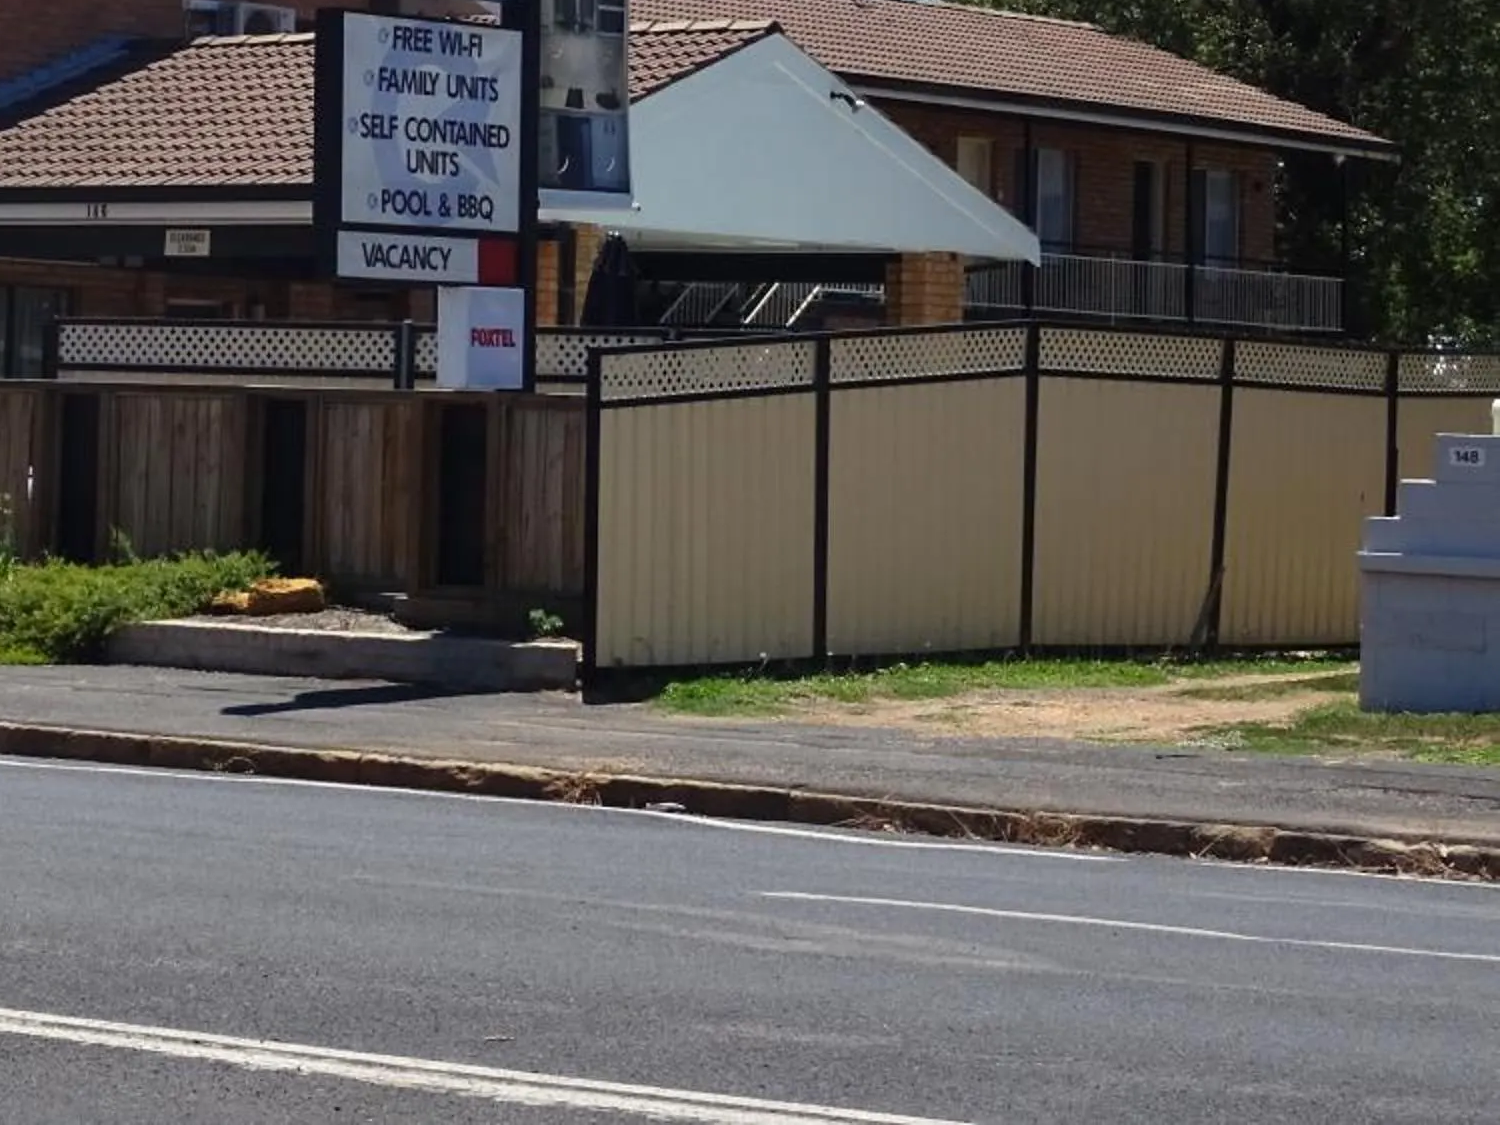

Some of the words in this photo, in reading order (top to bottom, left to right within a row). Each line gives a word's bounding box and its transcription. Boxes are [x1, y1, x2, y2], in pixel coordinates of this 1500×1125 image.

[392, 26, 433, 52] FREE
[439, 30, 482, 58] WI-FI
[378, 67, 440, 96] FAMILY
[446, 75, 499, 102] UNITS
[360, 113, 399, 140] SELF
[404, 117, 510, 149] CONTAINED
[406, 150, 460, 176] UNITS
[381, 189, 432, 217] POOL
[437, 194, 452, 217] &
[457, 195, 493, 222] BBQ
[362, 242, 452, 271] VACANCY
[470, 328, 516, 347] FOXTEL
